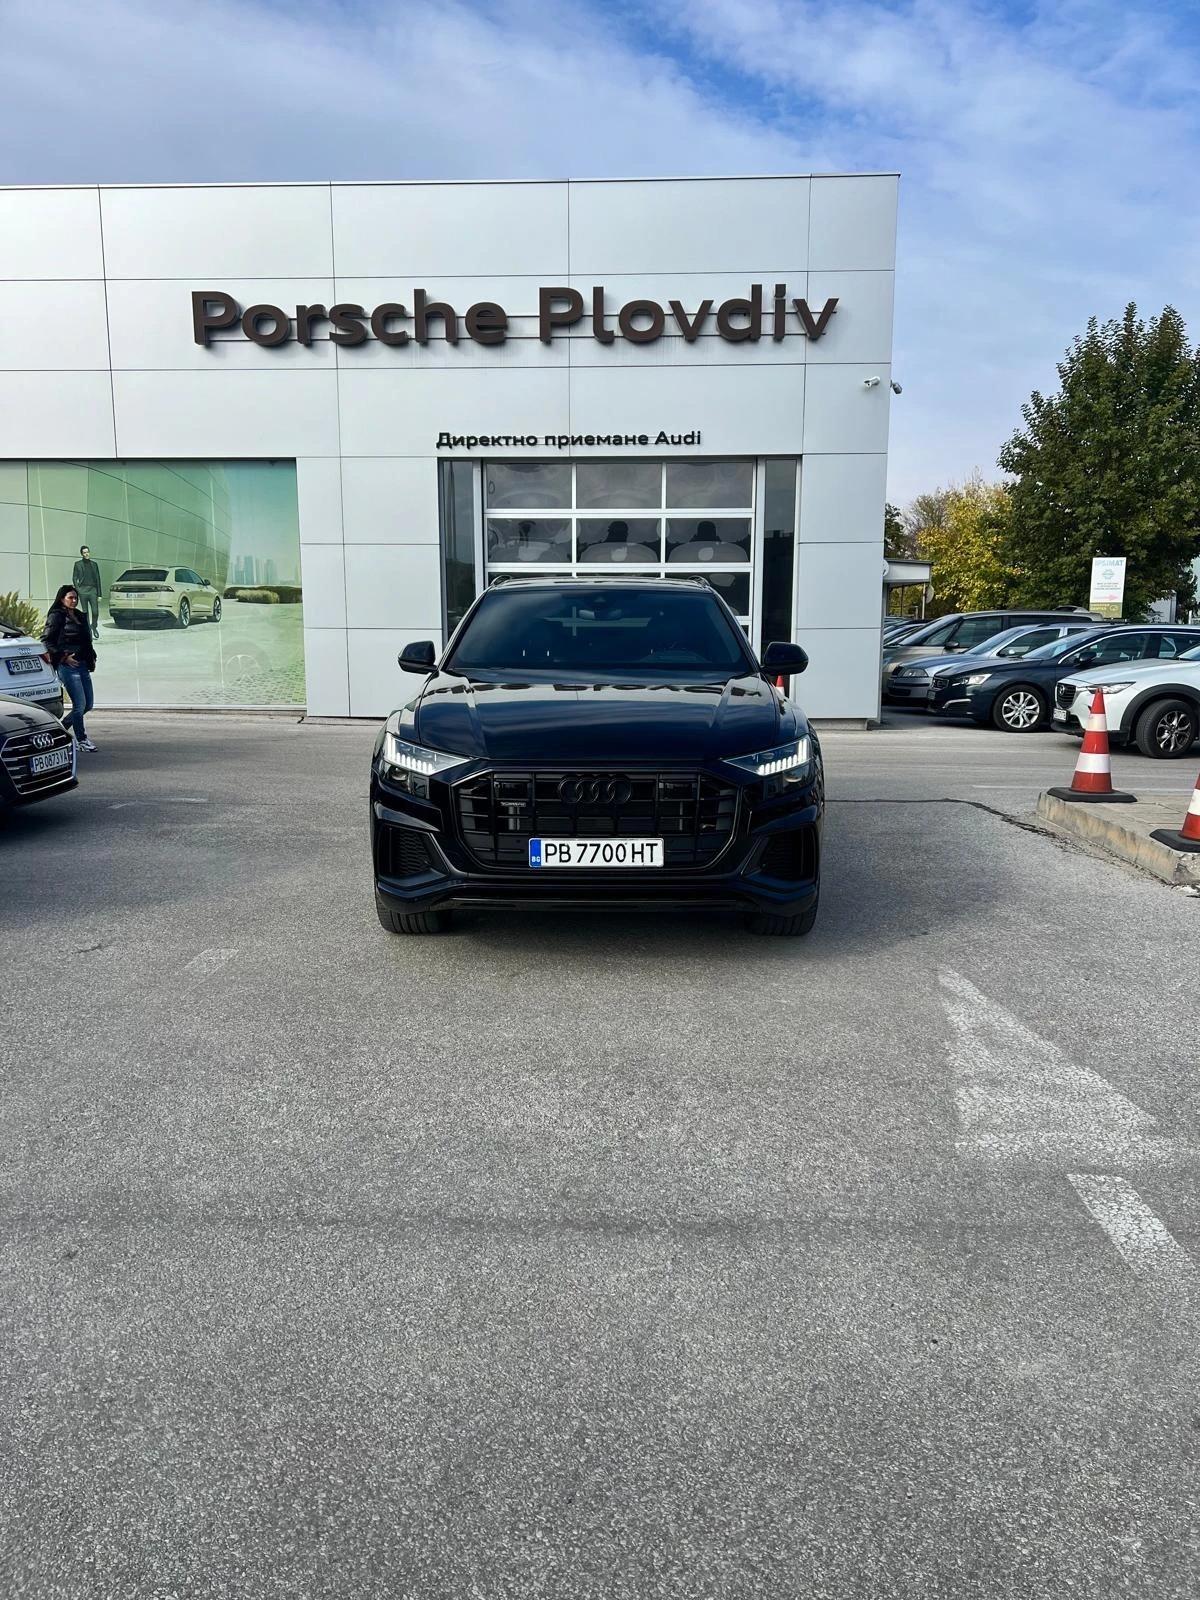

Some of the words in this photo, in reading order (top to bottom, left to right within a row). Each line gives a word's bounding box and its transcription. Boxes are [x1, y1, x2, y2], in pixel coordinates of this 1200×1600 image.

[191, 288, 508, 346] Porsche
[539, 283, 840, 344] Plovdiv
[436, 432, 538, 450] Директно
[544, 433, 649, 450] приемане
[654, 430, 701, 446] Audi
